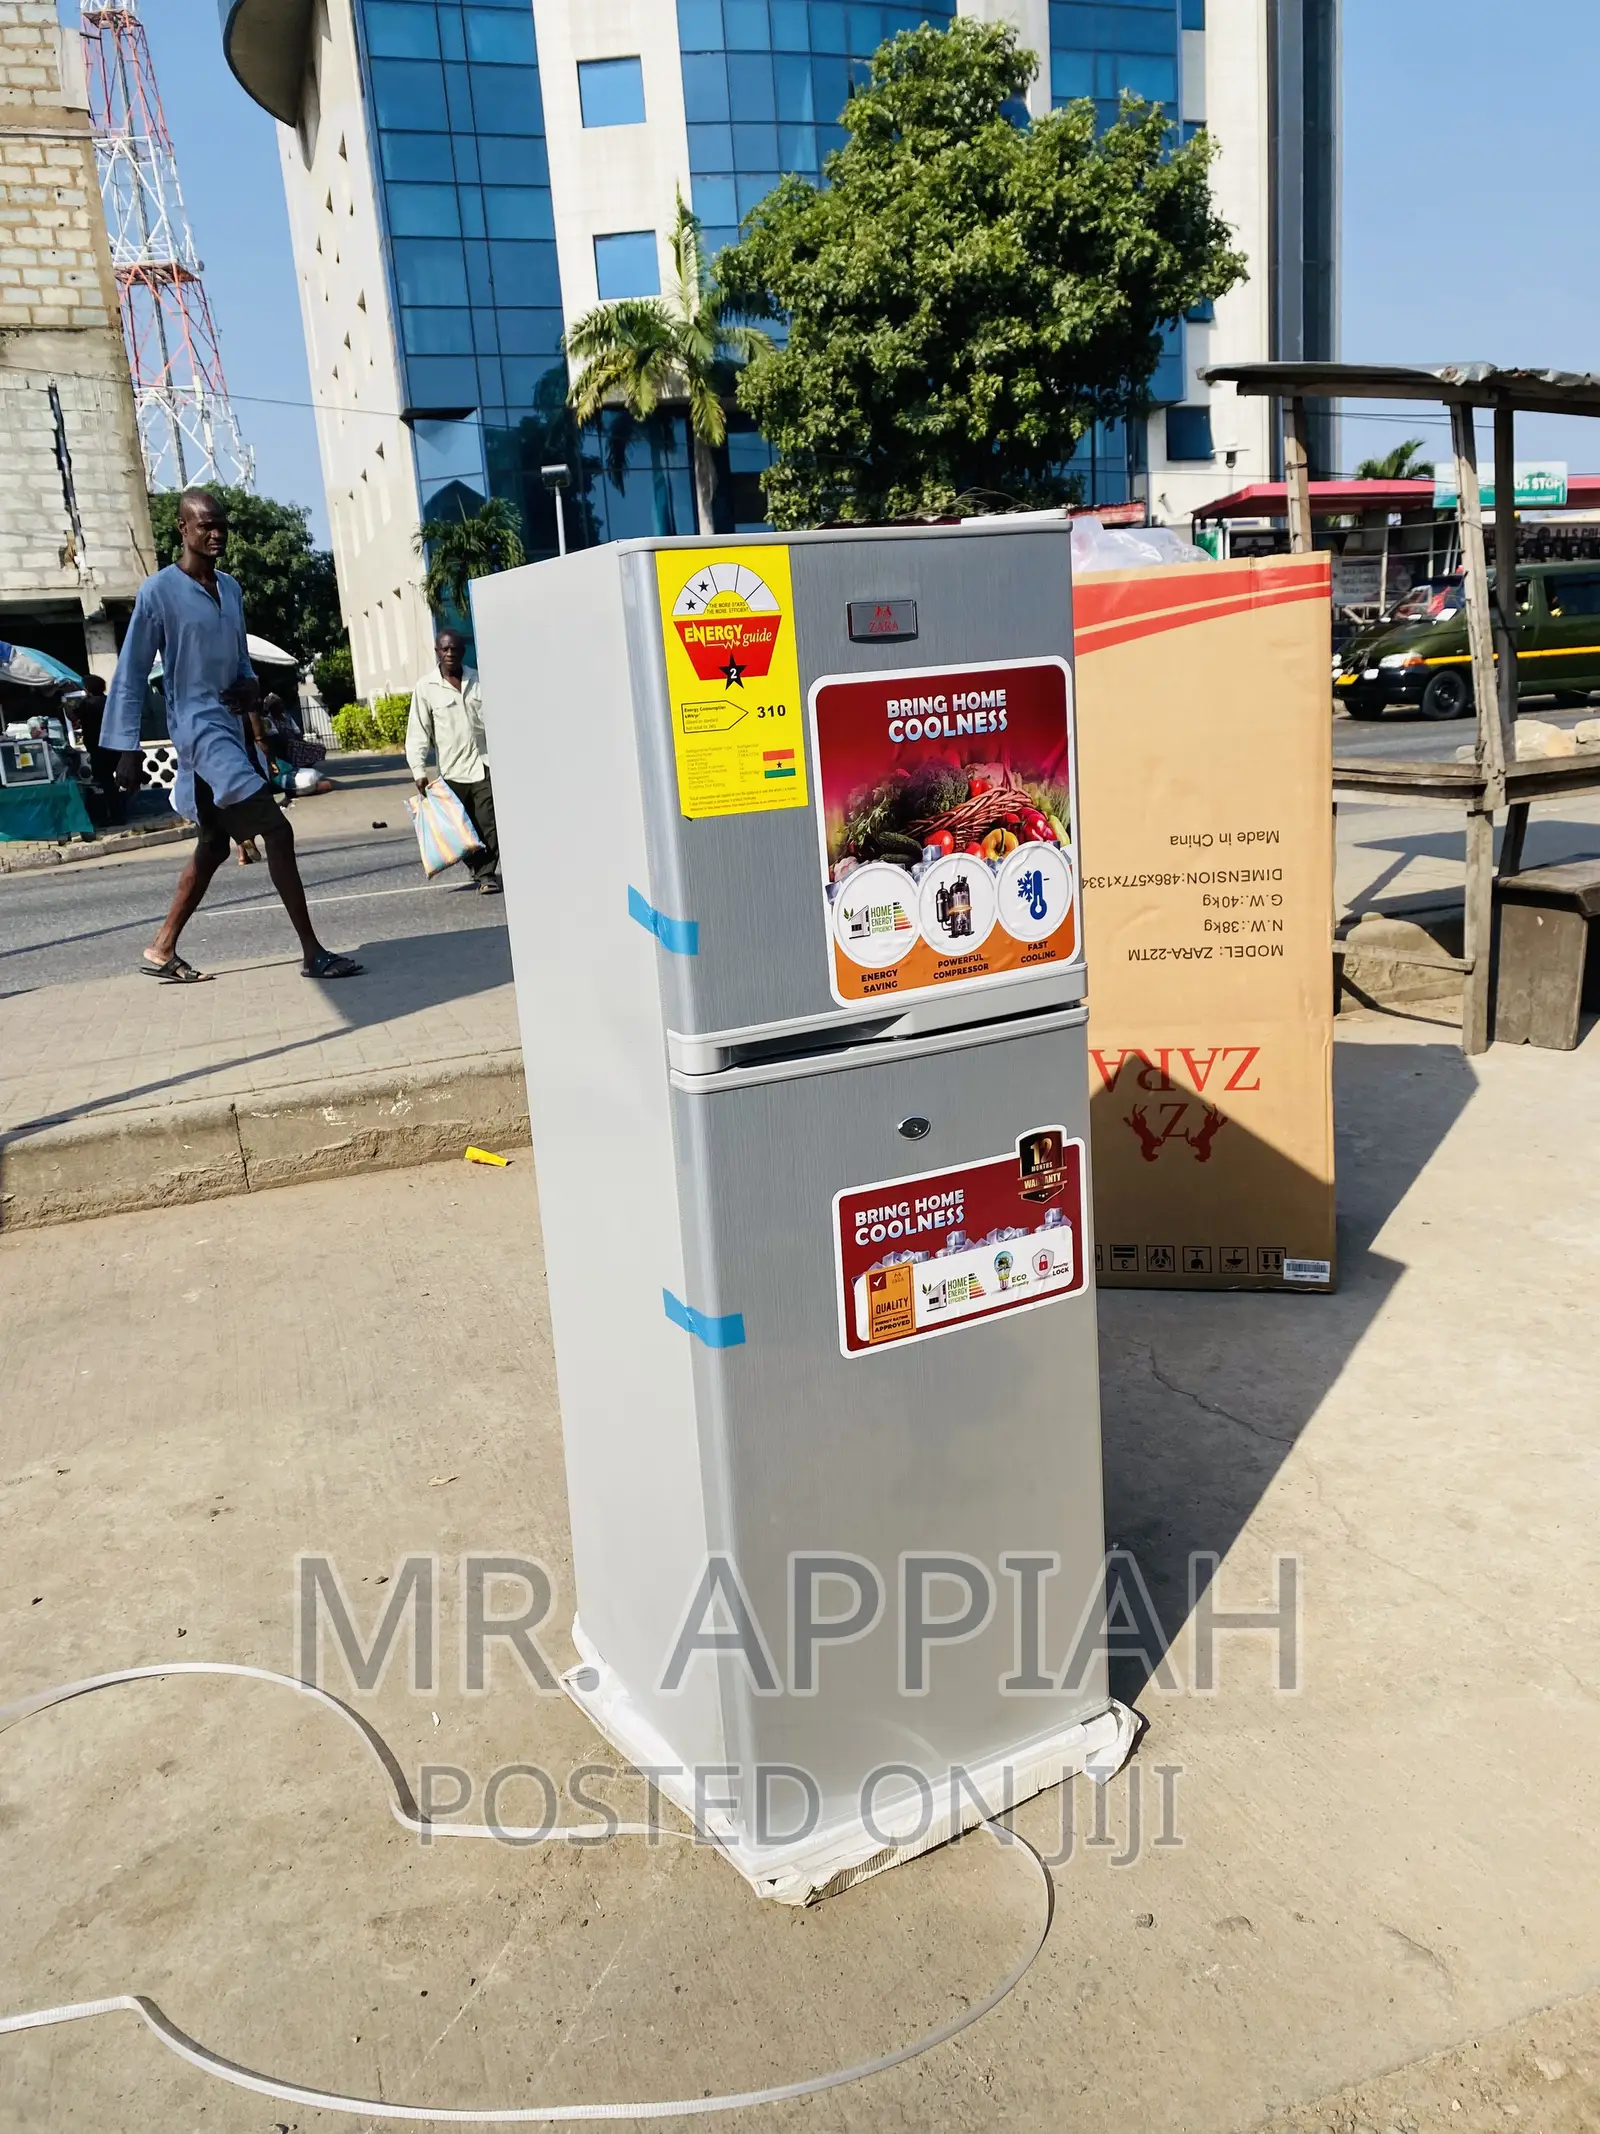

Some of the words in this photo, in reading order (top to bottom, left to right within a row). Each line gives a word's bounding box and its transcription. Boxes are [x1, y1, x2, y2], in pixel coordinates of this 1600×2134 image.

[1532, 477, 1563, 490] STOP
[869, 620, 899, 633] ZARA
[684, 621, 743, 648] ENERGY
[742, 627, 772, 647] guide
[729, 667, 737, 680] 2
[886, 694, 948, 719] BRING
[952, 688, 1007, 711] HOME
[756, 704, 786, 719] 310
[888, 708, 1008, 744] COOLNESS
[1170, 833, 1214, 847] China
[1219, 832, 1232, 845] in
[1237, 830, 1280, 845] Made
[870, 904, 893, 918] HOME
[871, 916, 893, 927] ENERGY
[1027, 940, 1048, 952] FAST
[1128, 946, 1213, 961] ZARA-22TM
[1219, 944, 1284, 958] MODEL:
[937, 953, 984, 969] POWERFUL
[1020, 949, 1056, 964] COOLING
[861, 968, 898, 983] ENERGY
[933, 962, 989, 980] COMPRESSOR
[863, 981, 898, 994] SAVING
[1088, 1047, 1261, 1093] ZARA
[1159, 1103, 1190, 1138] Z
[1030, 1137, 1053, 1165] 12
[1031, 1161, 1053, 1173] MONTHS
[1024, 1172, 1061, 1190] WAANTY
[855, 1201, 911, 1228] BRING
[914, 1188, 965, 1211] HOME
[855, 1206, 965, 1247] COOLNESS
[1011, 1273, 1027, 1284] ECO
[1052, 1266, 1070, 1276] LOCK
[947, 1276, 968, 1291] HOME
[948, 1287, 968, 1298] ENERGY
[875, 1296, 909, 1315] QUALITY
[874, 1318, 893, 1326] ENERGY
[893, 1314, 909, 1322] RATING
[874, 1319, 911, 1333] APPROVED
